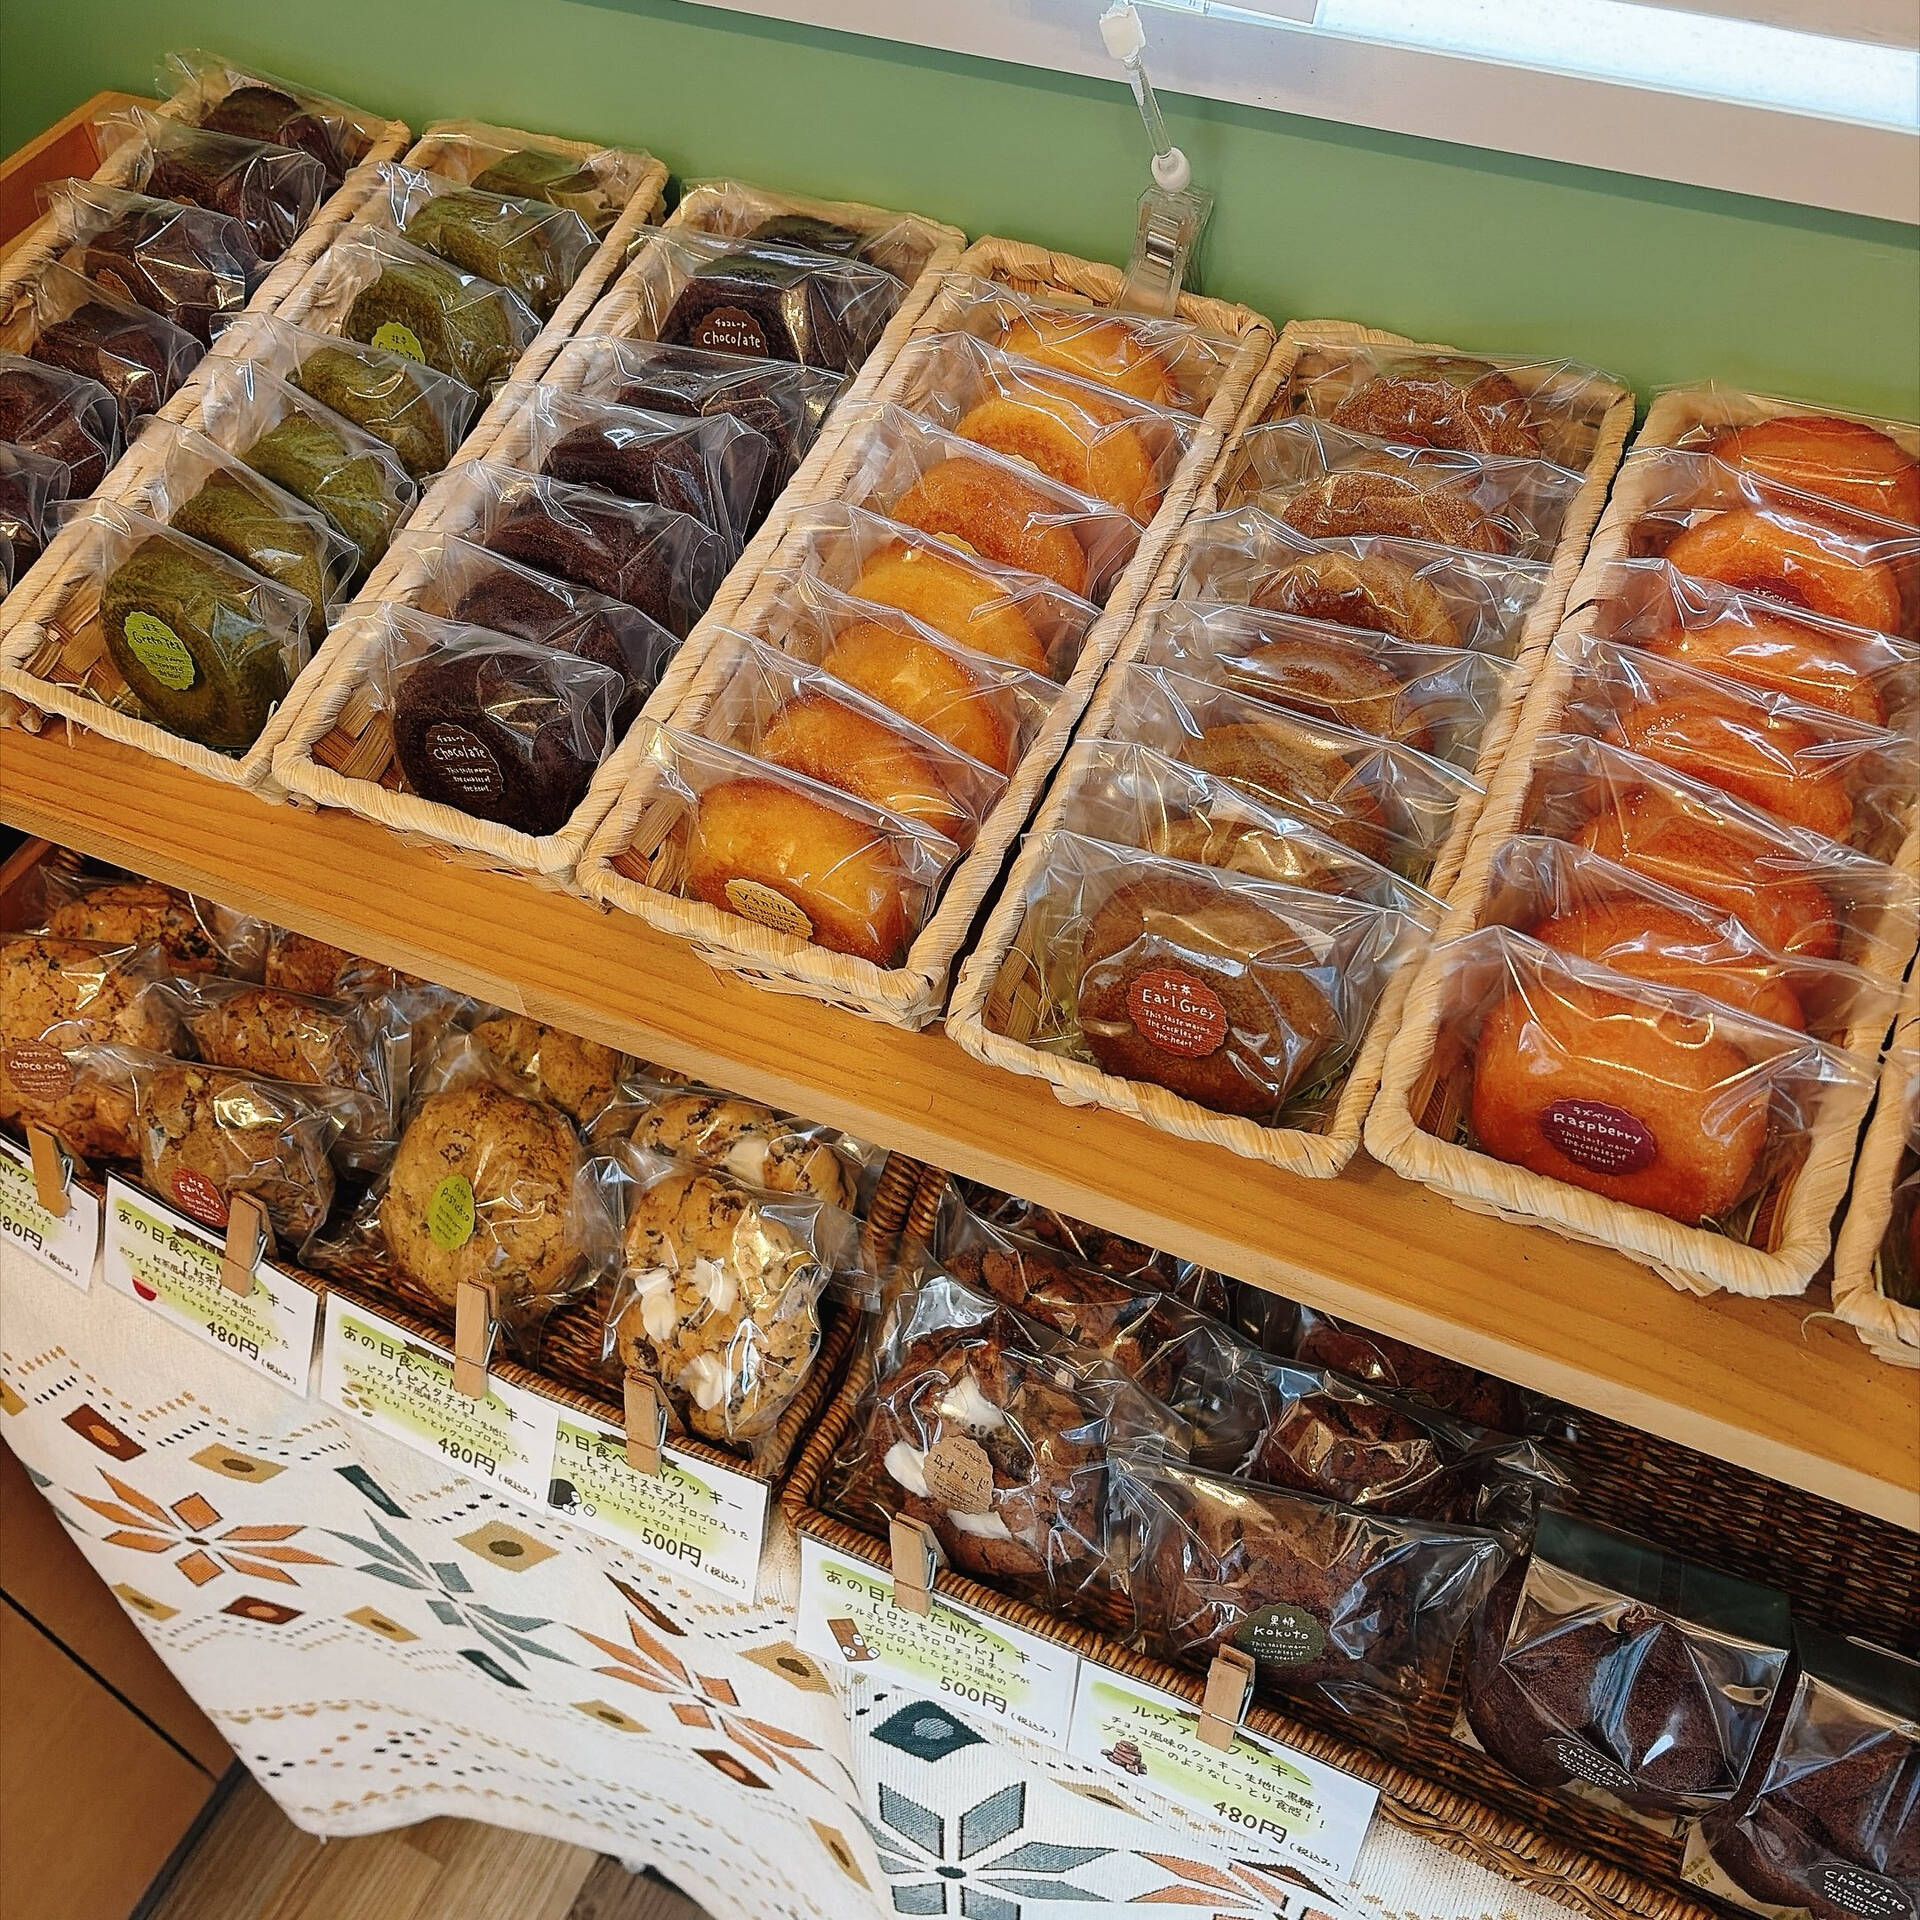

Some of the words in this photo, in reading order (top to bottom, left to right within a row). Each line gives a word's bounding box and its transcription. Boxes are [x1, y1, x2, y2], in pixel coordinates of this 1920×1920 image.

[703, 330, 761, 348] Chocolate
[433, 745, 487, 760] Chocolate
[736, 891, 797, 917] Vanilla
[1142, 988, 1176, 1008] Earl
[1180, 999, 1216, 1020] Grey
[1164, 980, 1192, 996] 紅茶
[44, 1062, 67, 1072] nuts
[1553, 1113, 1642, 1145] Raspberry
[1573, 1106, 1621, 1122] ラズベリー
[0, 1218, 42, 1250] 80円
[118, 1208, 295, 1315] あの日食べたNッキー
[207, 1320, 259, 1360] 480円
[343, 1325, 535, 1429] あの日食べたッキー
[439, 1436, 495, 1477] 480円
[643, 1528, 702, 1568] 500円
[825, 1569, 1052, 1672] あの日たNYクッキー
[1253, 1625, 1309, 1640] Kokuto
[941, 1676, 1007, 1715] 500円
[1133, 1704, 1311, 1787] ルヴァクッキー
[1557, 1744, 1630, 1786] Chocolate
[1213, 1800, 1286, 1844] 480円
[1825, 1870, 1906, 1911] Chocolate
